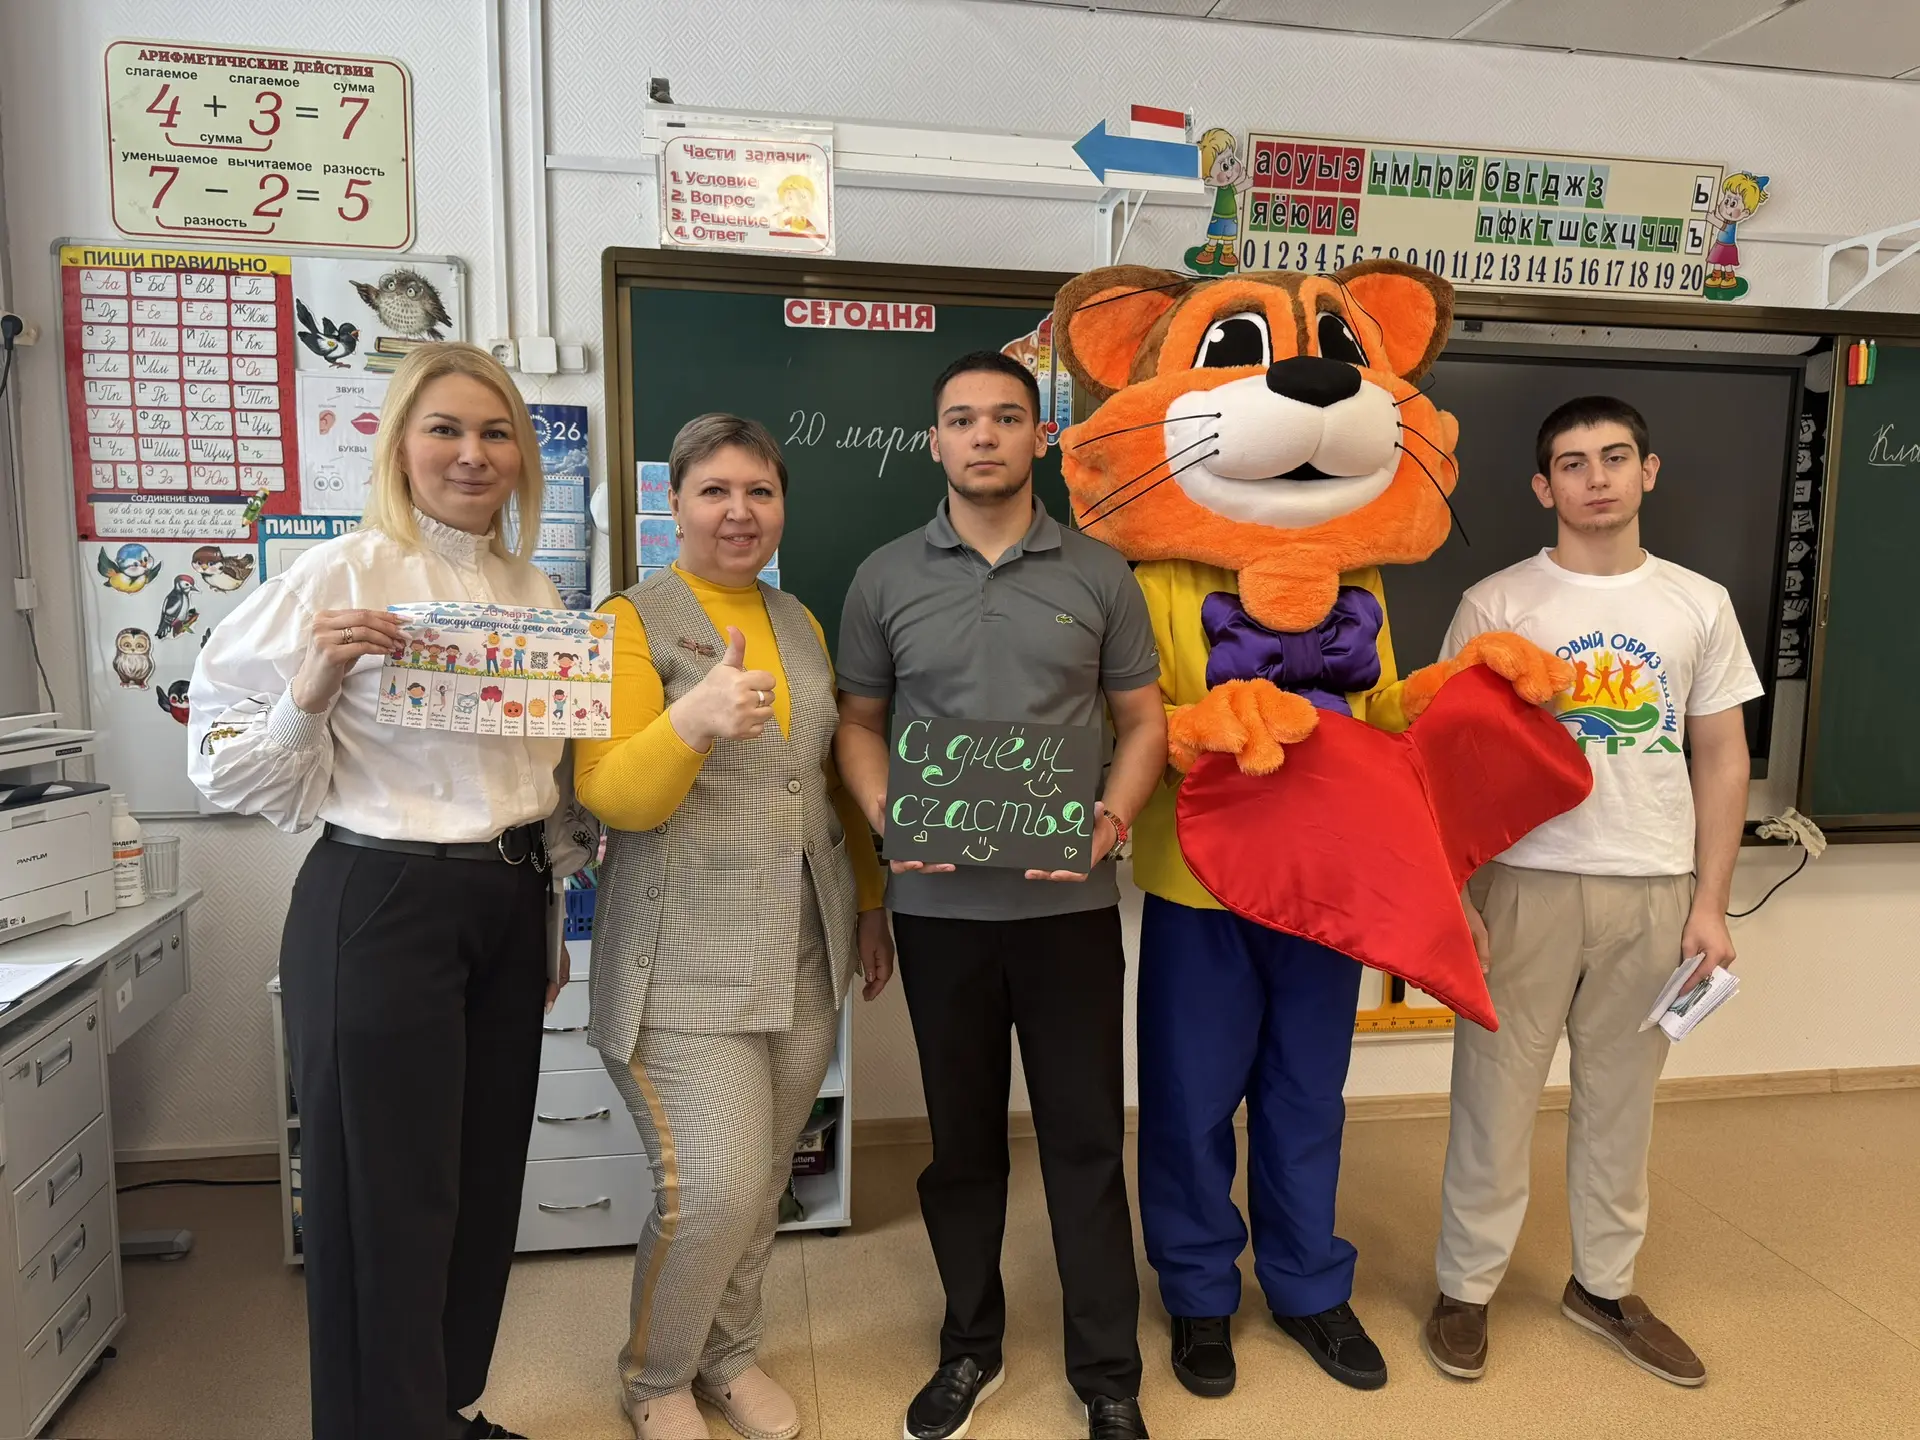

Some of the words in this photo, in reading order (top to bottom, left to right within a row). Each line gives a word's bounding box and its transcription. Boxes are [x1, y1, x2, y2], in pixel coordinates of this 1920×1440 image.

[138, 50, 289, 71] АРИФМЕТИЧЕСКИЕ
[293, 62, 374, 77] ДЕЙСТВИЯ
[126, 66, 198, 80] слагаемое
[229, 73, 299, 88] слагаемое
[333, 82, 374, 93] сумма
[146, 84, 181, 128] 4
[249, 91, 282, 135] 3
[340, 97, 369, 139] 7
[200, 133, 242, 144] сумма
[683, 144, 735, 161] Части
[122, 152, 218, 165] уменьшаемое
[228, 156, 312, 171] вычитаемое
[323, 163, 385, 177] разность
[671, 171, 681, 184] 1.
[685, 171, 758, 188] Условие
[149, 166, 179, 208] 7
[253, 174, 289, 217] 2
[338, 179, 372, 221] 5
[671, 190, 685, 202] 2.
[691, 191, 754, 207] Вопрос
[184, 216, 247, 228] разность
[672, 209, 684, 221] 3.
[691, 209, 769, 228] Решение
[674, 226, 688, 239] 4.
[693, 227, 746, 241] Ответ
[84, 251, 144, 267] ПИШИ
[152, 254, 267, 272] ПРАВИЛЬНО
[1243, 239, 1255, 268] 0
[1262, 240, 1270, 268] 1
[1278, 241, 1289, 269] 2
[1295, 241, 1308, 270] 3
[1314, 243, 1326, 271] 4
[1333, 244, 1345, 272] 5
[1351, 245, 1364, 262] 6
[1406, 248, 1417, 265] 9
[1425, 248, 1445, 276] 10
[1451, 250, 1468, 279] 11
[1473, 251, 1494, 280] 12
[1499, 252, 1520, 281] 13
[1525, 255, 1546, 283] 14
[1552, 256, 1574, 284] 15
[1578, 257, 1599, 285] 16
[1604, 259, 1624, 286] 17
[1628, 261, 1648, 288] 18
[1653, 262, 1674, 289] 19
[1679, 263, 1703, 290] 20
[85, 272, 93, 281] А
[135, 273, 143, 283] Б
[185, 275, 192, 284] В
[234, 277, 241, 286] Г
[85, 299, 94, 311] Д
[137, 301, 144, 311] Е
[186, 302, 194, 312] Ё
[234, 304, 246, 314] Ж
[786, 300, 933, 330] СЕГОДНЯ
[87, 326, 94, 336] З
[137, 329, 145, 337] И
[187, 329, 195, 339] Й
[236, 331, 243, 341] К
[87, 354, 96, 364] Л
[136, 356, 146, 365] М
[187, 358, 195, 367] Н
[237, 358, 245, 368] О
[88, 382, 97, 392] П
[139, 384, 147, 394] Р
[189, 384, 197, 394] С
[238, 386, 246, 395] Т
[91, 409, 99, 419] У
[140, 412, 149, 420] Ф
[191, 412, 199, 422] Х
[240, 413, 249, 425] Ц
[785, 410, 826, 446] 20
[93, 438, 101, 447] Ч
[142, 439, 152, 448] Ш
[192, 440, 203, 452] Щ
[146, 466, 154, 475] Э
[194, 467, 206, 476] Ю
[244, 468, 252, 477] Я
[131, 495, 186, 503] СОЕДИНЕНИЕ
[266, 520, 326, 534] ПИШИ
[483, 608, 498, 616] 20
[502, 611, 533, 619] марта
[423, 613, 520, 630] Международный
[522, 625, 544, 634] день
[547, 626, 587, 635] счастья
[1556, 631, 1604, 660] ОВЫЙ
[1611, 634, 1661, 669] ОБРАЗ
[1577, 736, 1682, 754] ГРА
[898, 720, 932, 763] С
[922, 725, 1073, 786] днём
[17, 853, 48, 864] PANTUM
